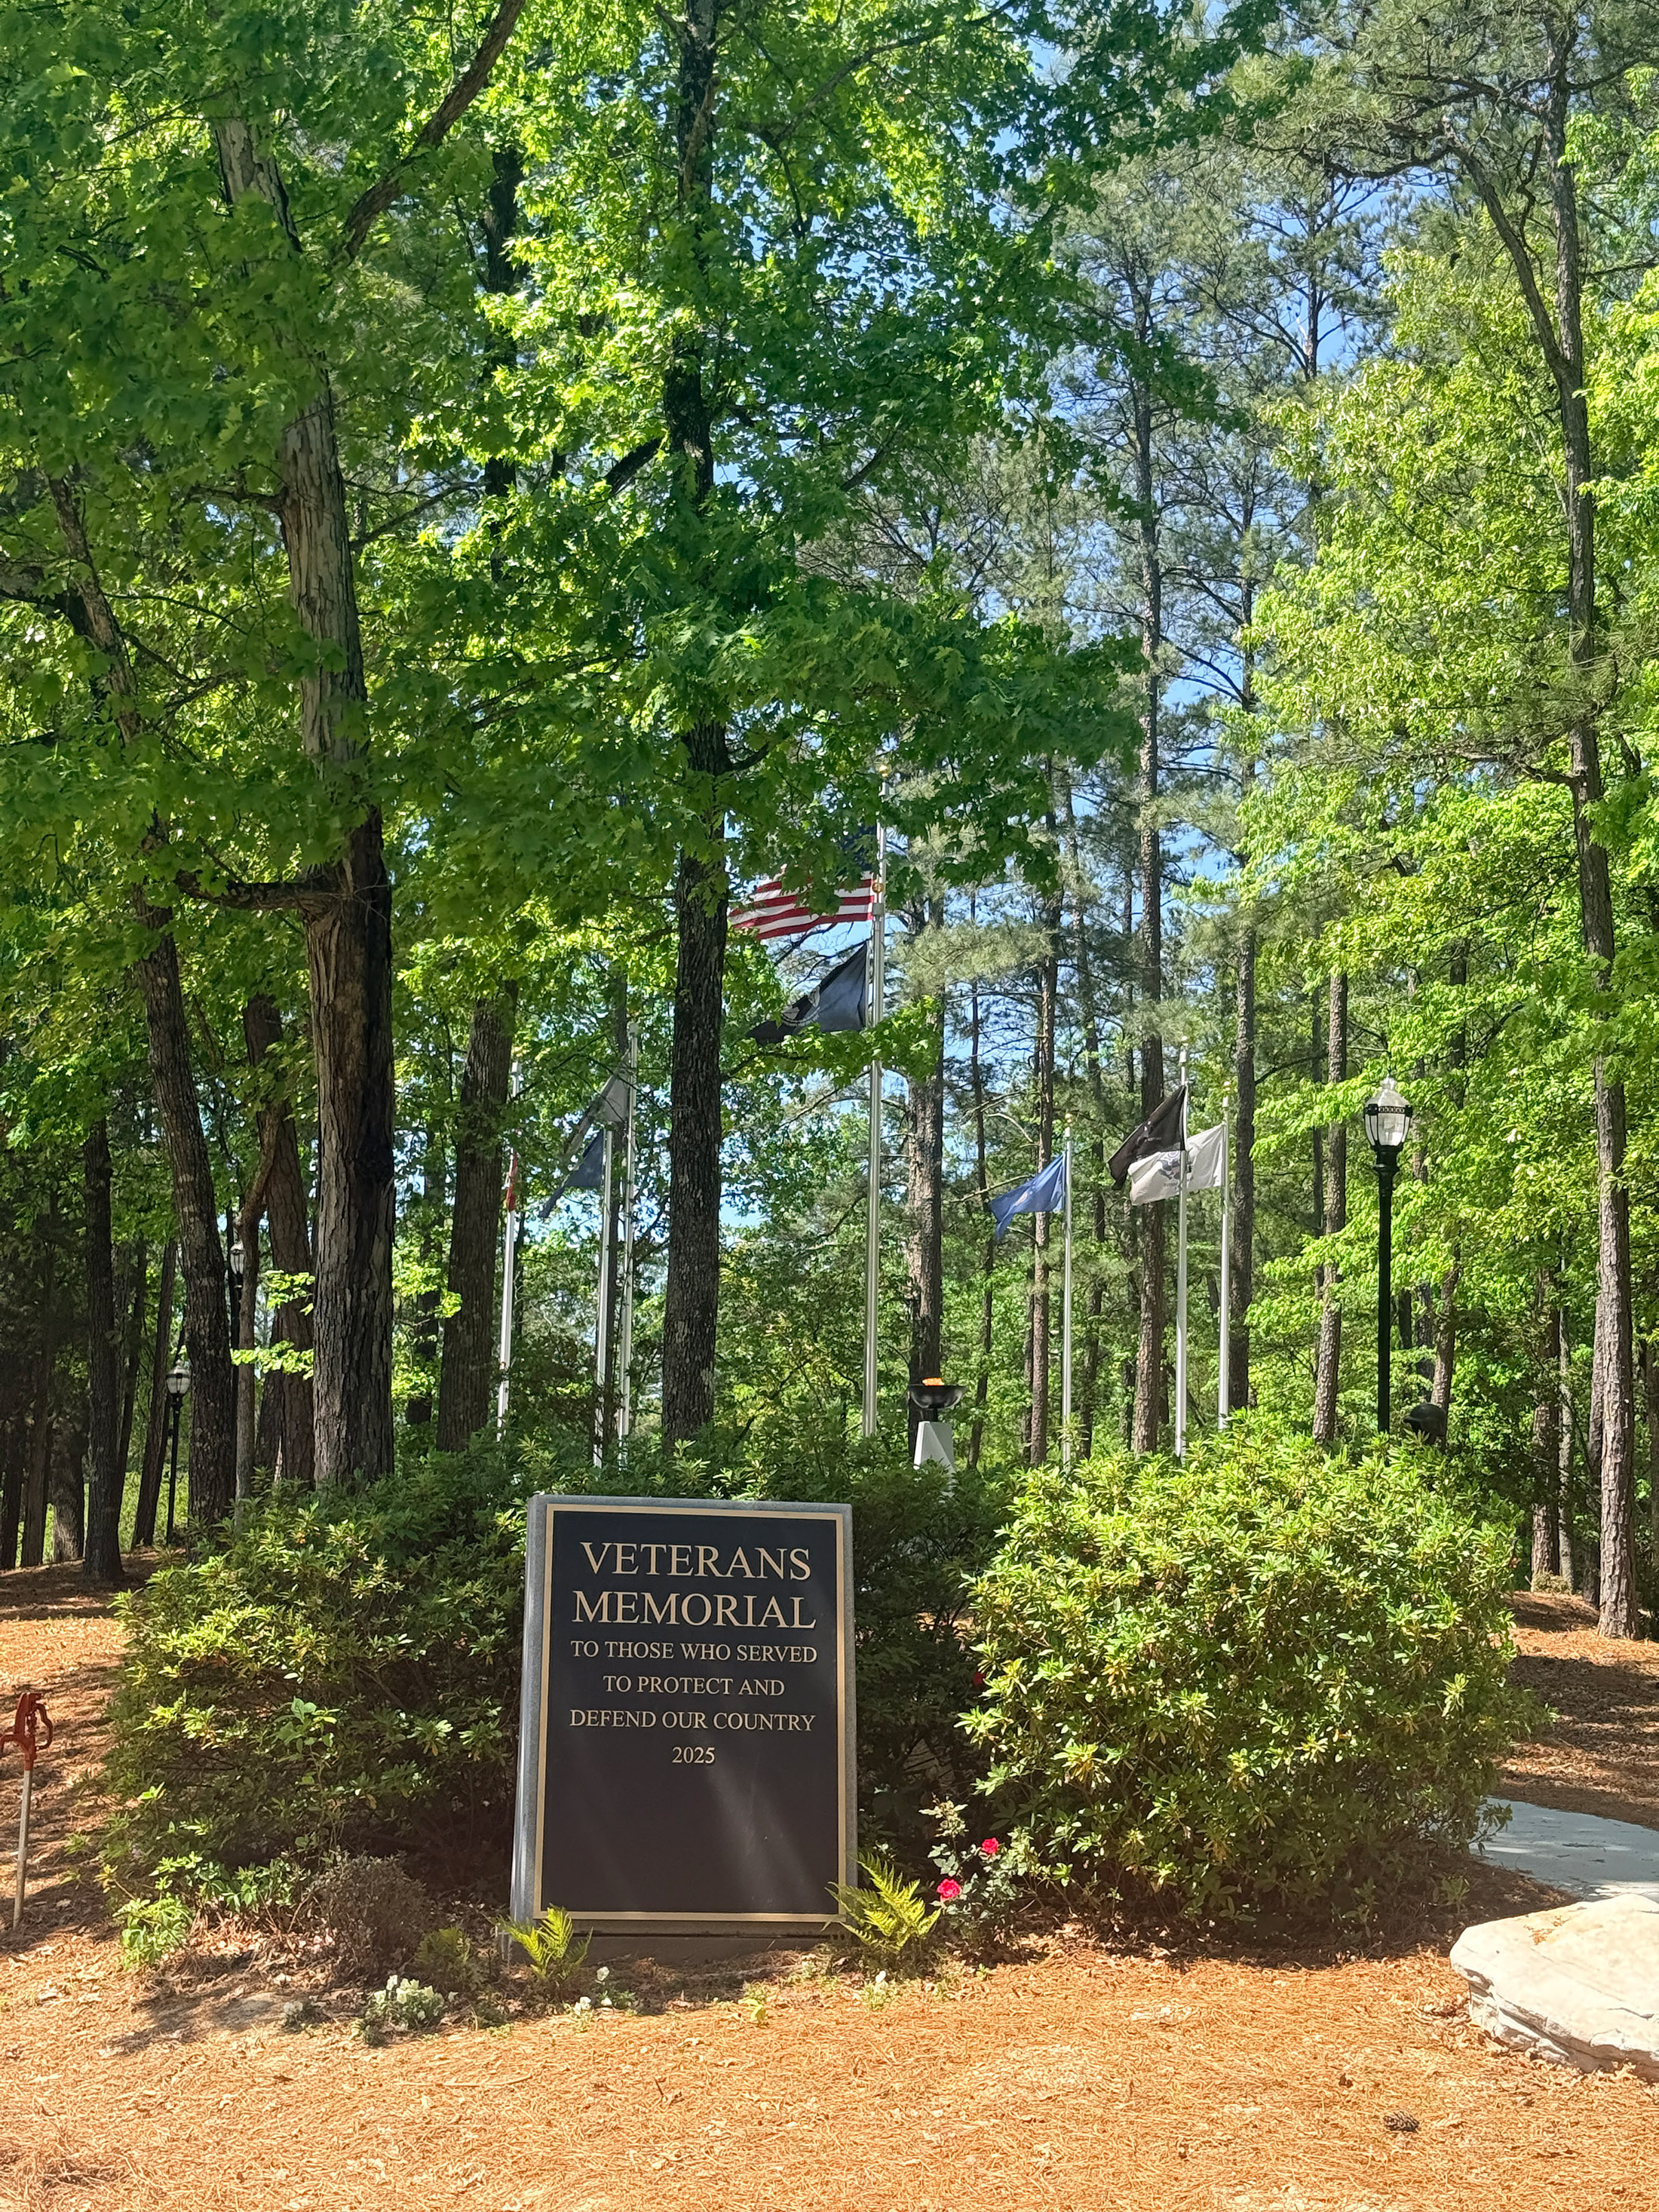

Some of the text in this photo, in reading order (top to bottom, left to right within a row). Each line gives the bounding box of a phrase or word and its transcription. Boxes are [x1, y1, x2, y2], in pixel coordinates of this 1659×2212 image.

[580, 1542, 811, 1581] VETERANS
[572, 1591, 817, 1629] MEMORIAL
[570, 1640, 817, 1663] TO THOSE WHO SERVED
[603, 1675, 785, 1696] TO PROTECT AND
[569, 1709, 816, 1732] DEFEND OUR COUNTRY
[672, 1746, 715, 1764] 2025
